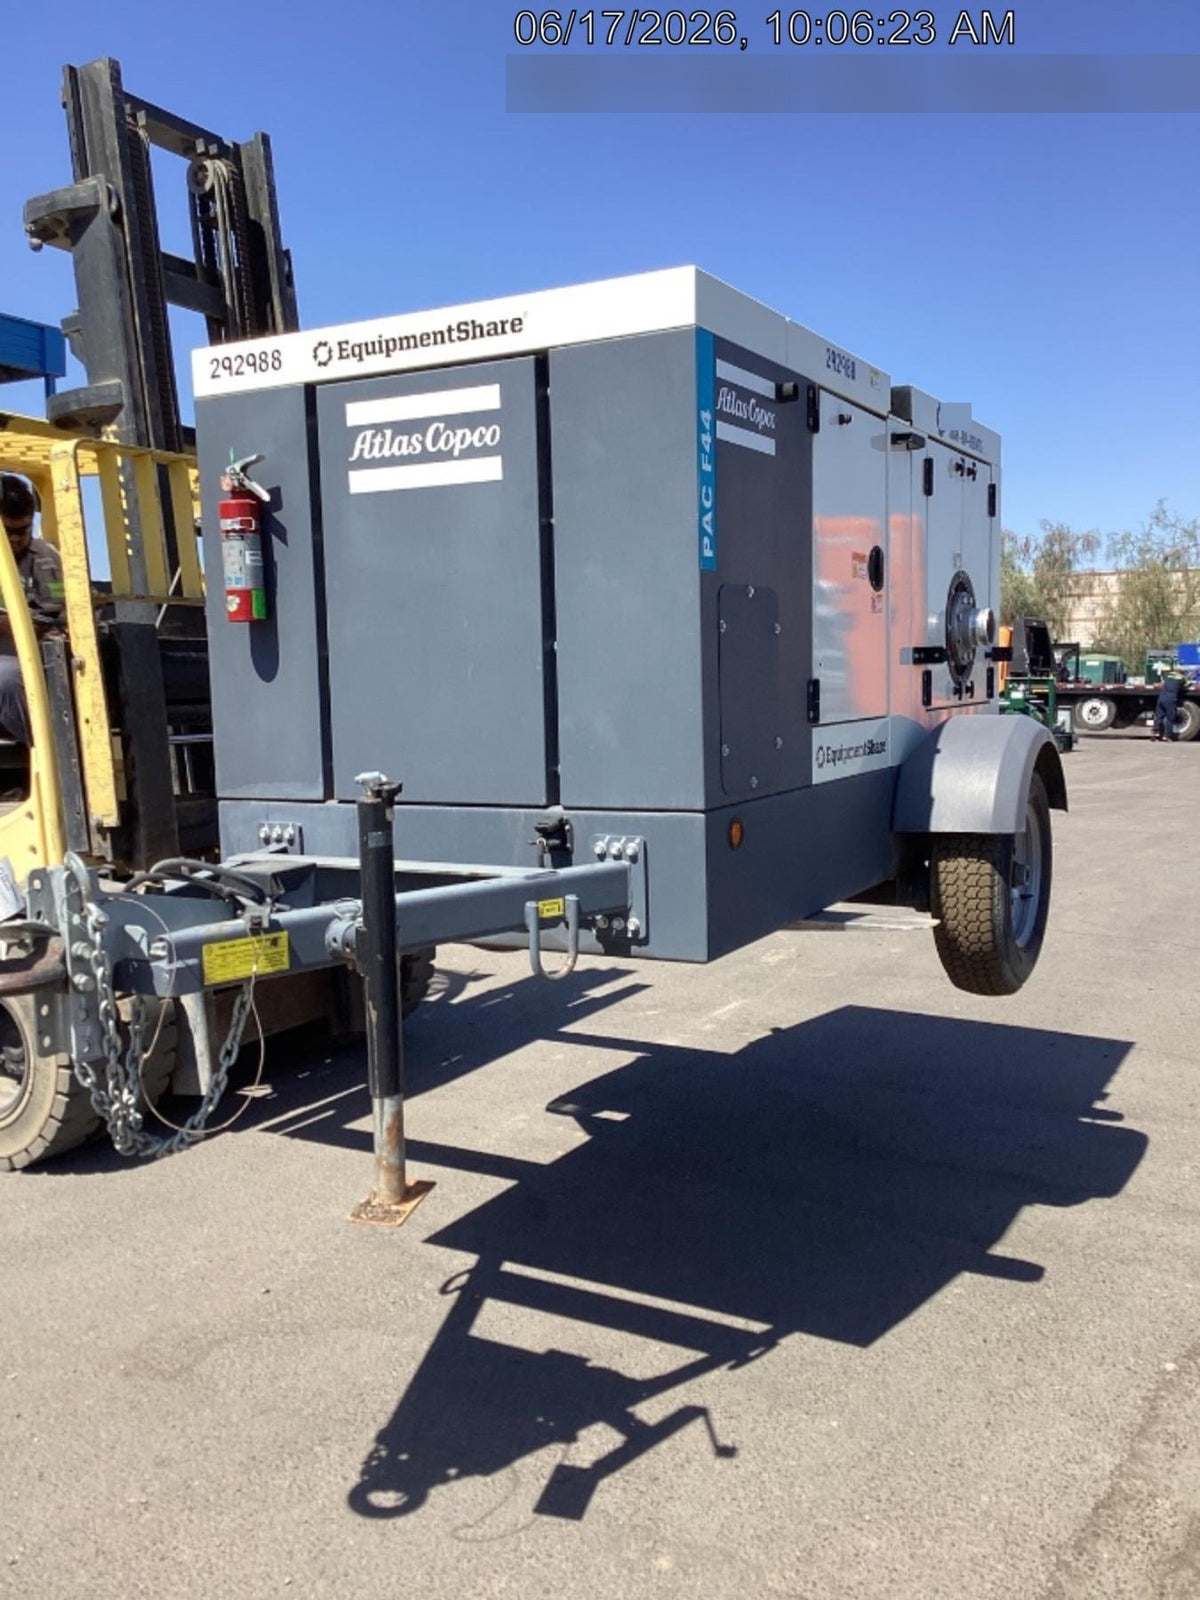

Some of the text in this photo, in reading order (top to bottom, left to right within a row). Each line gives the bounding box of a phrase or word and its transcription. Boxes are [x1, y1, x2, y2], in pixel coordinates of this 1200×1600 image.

[337, 315, 525, 362] EquipmentShare
[210, 349, 283, 379] 292988
[715, 386, 748, 420] Atlas
[348, 422, 501, 461] Atlas Copco
[700, 409, 714, 558] PAC F44
